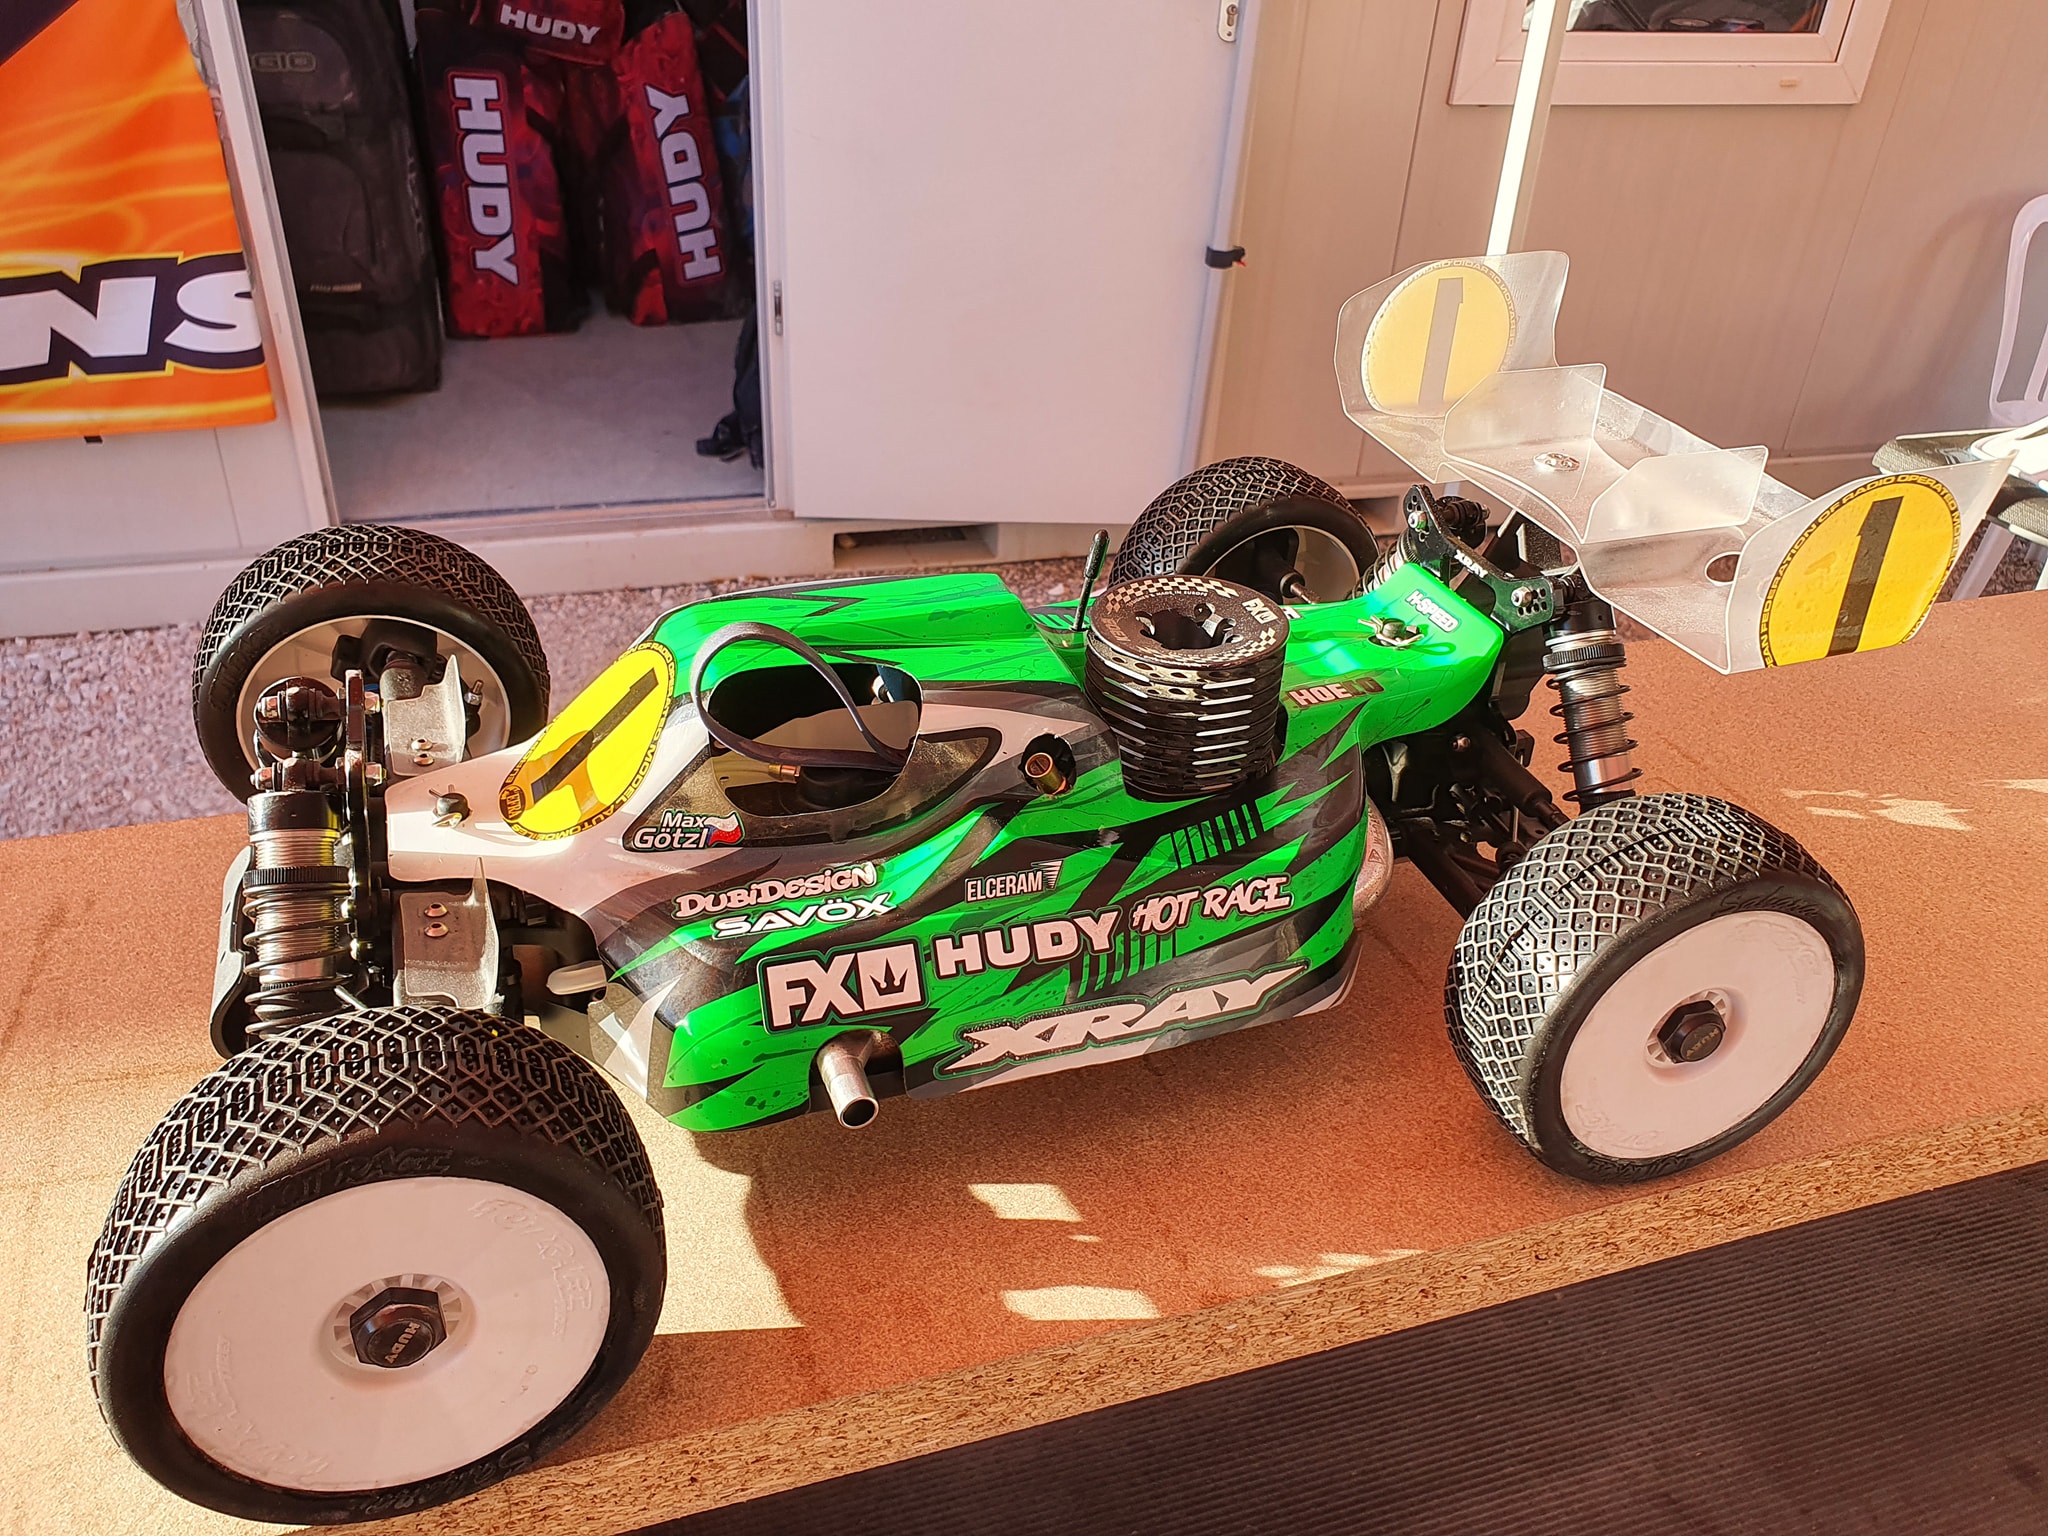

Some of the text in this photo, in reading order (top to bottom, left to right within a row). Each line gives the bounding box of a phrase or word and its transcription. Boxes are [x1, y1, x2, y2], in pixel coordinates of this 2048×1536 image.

[500, 4, 601, 45] HUDY
[453, 77, 519, 286] HUDY
[645, 85, 722, 280] HUDY
[1454, 548, 1488, 579] XRAY
[1760, 524, 1817, 633] FEDERATION
[1818, 503, 1841, 523] OF
[1841, 477, 1896, 505] RADIO
[1896, 474, 1958, 513] OPERATED
[1825, 495, 1905, 658] 1
[1405, 589, 1459, 632] H-SPEED
[616, 743, 657, 805] MODEL
[662, 811, 705, 829] Max
[713, 892, 897, 938] SAVÖX
[966, 874, 1044, 902] ELCERAM
[935, 876, 1290, 978] HUDY HOT RACE
[944, 965, 1309, 1071] XRAY
[384, 1321, 421, 1364] HUDY
